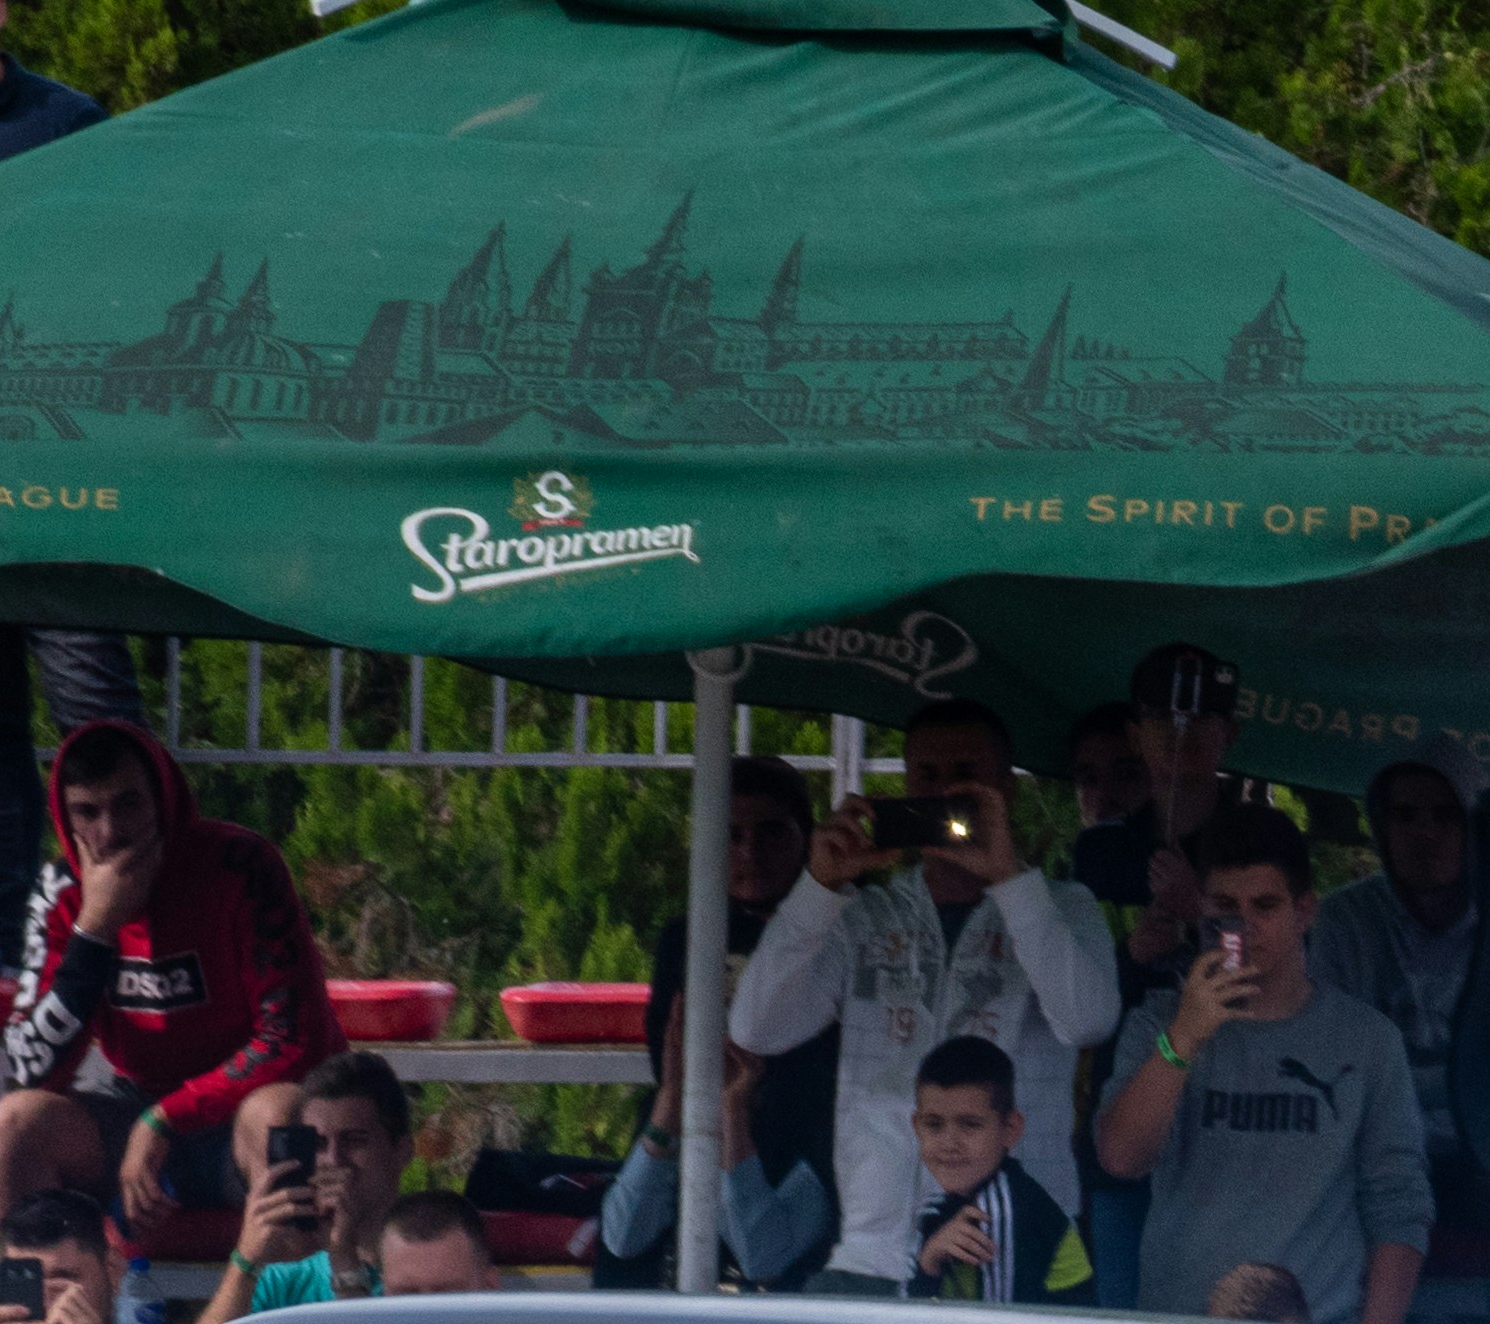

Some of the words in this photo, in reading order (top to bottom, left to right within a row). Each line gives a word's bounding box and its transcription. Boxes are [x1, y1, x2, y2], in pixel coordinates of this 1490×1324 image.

[968, 495, 1065, 523] THE
[1085, 494, 1245, 529] SPIRIT
[1262, 504, 1329, 537] OF
[401, 506, 698, 601] Staropramen
[1202, 1090, 1318, 1134] PUMA
